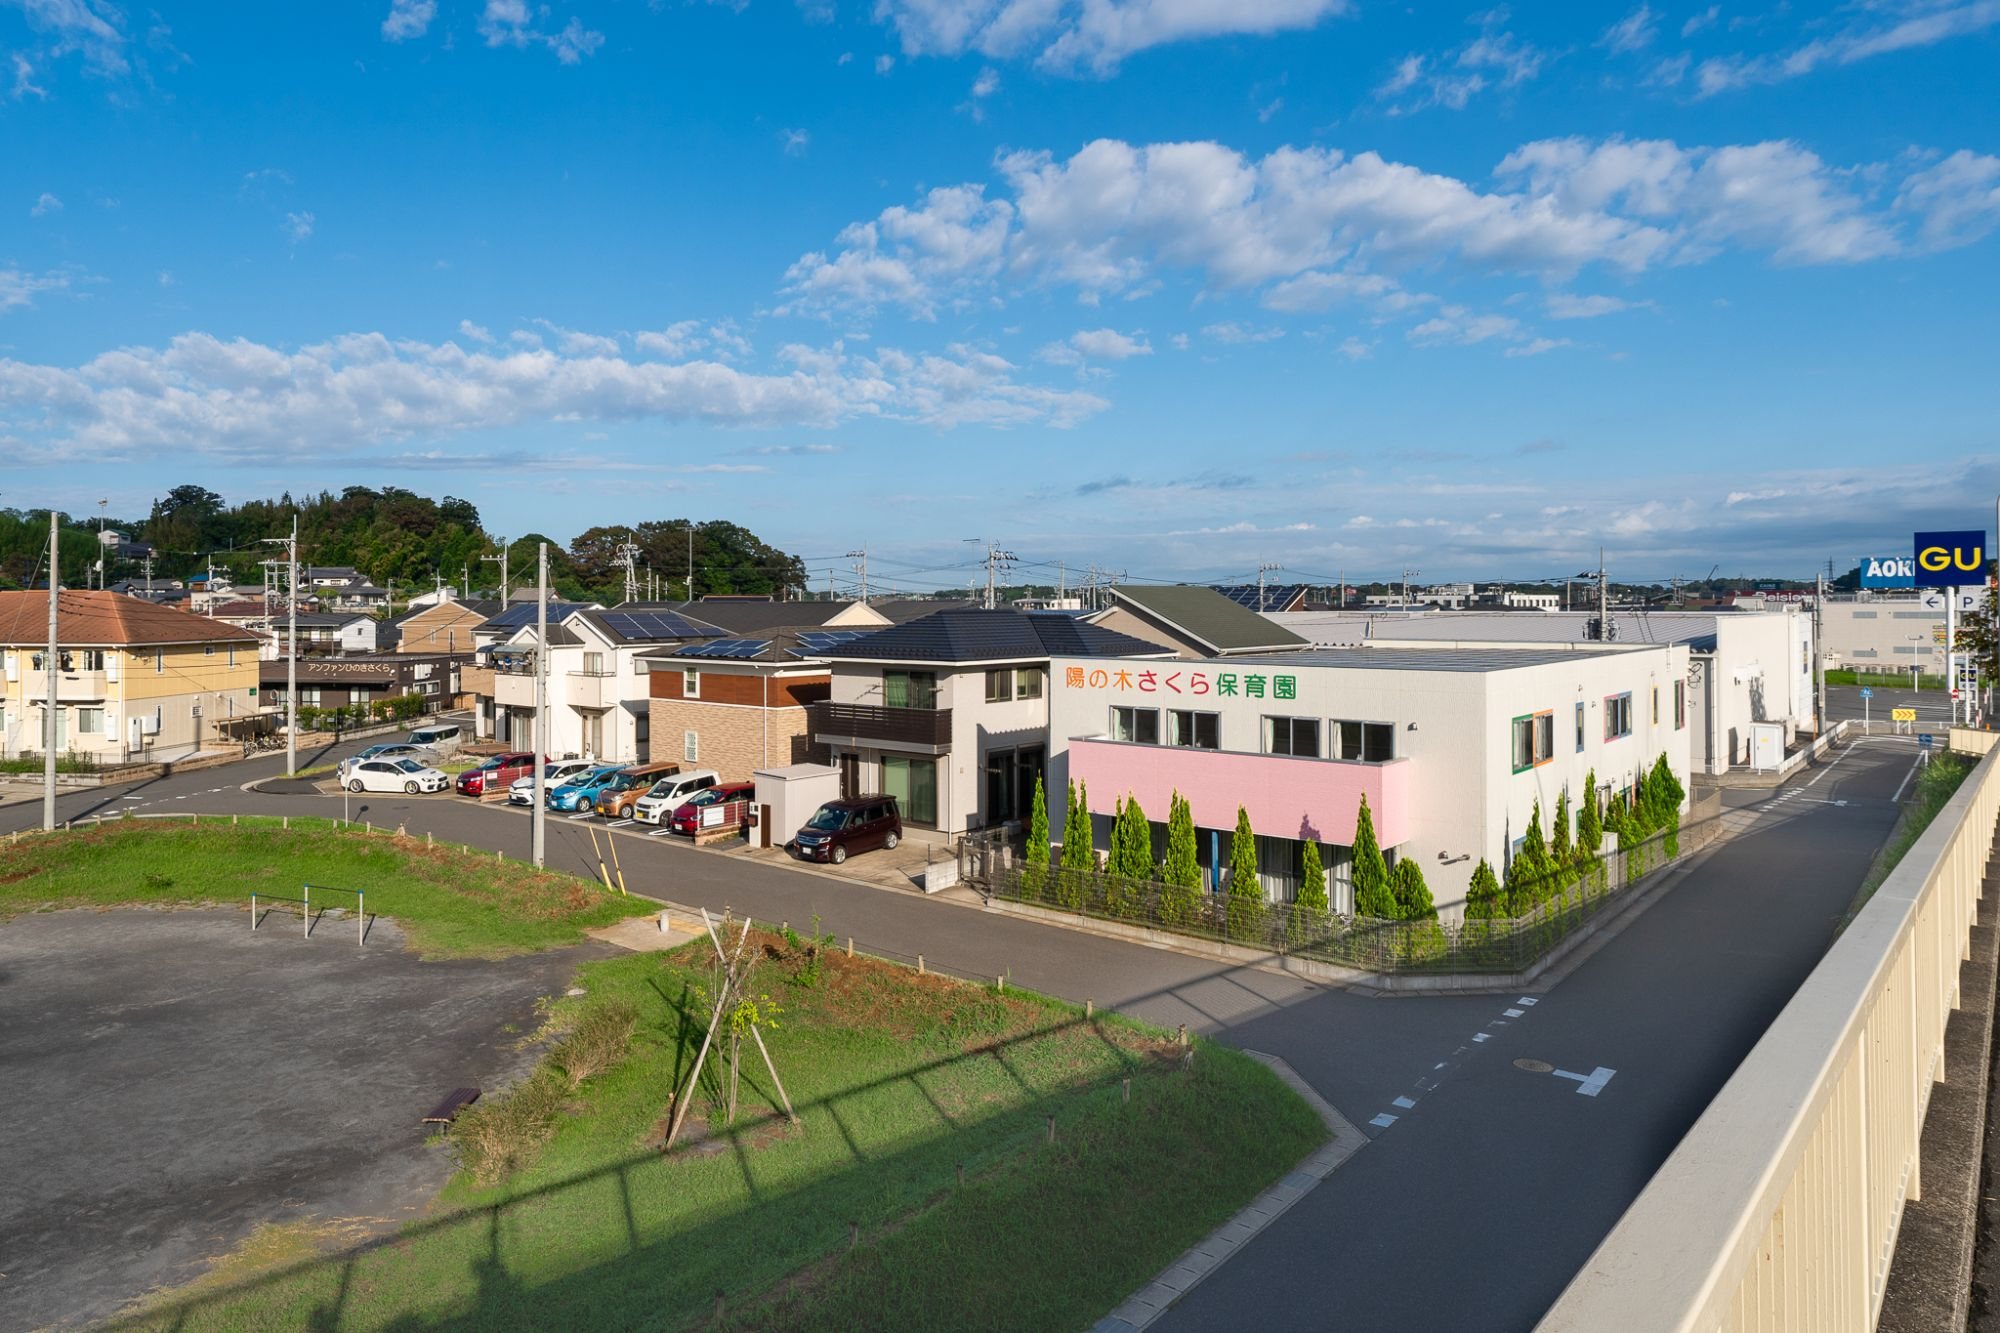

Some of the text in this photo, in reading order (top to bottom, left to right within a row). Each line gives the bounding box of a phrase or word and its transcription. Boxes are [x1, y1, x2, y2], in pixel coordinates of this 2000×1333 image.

[1919, 546, 1981, 572] GU
[1963, 597, 1974, 608] P
[308, 663, 390, 672] アンファンひのきさくら
[1066, 667, 1297, 699] 陽の木さくら保育園
